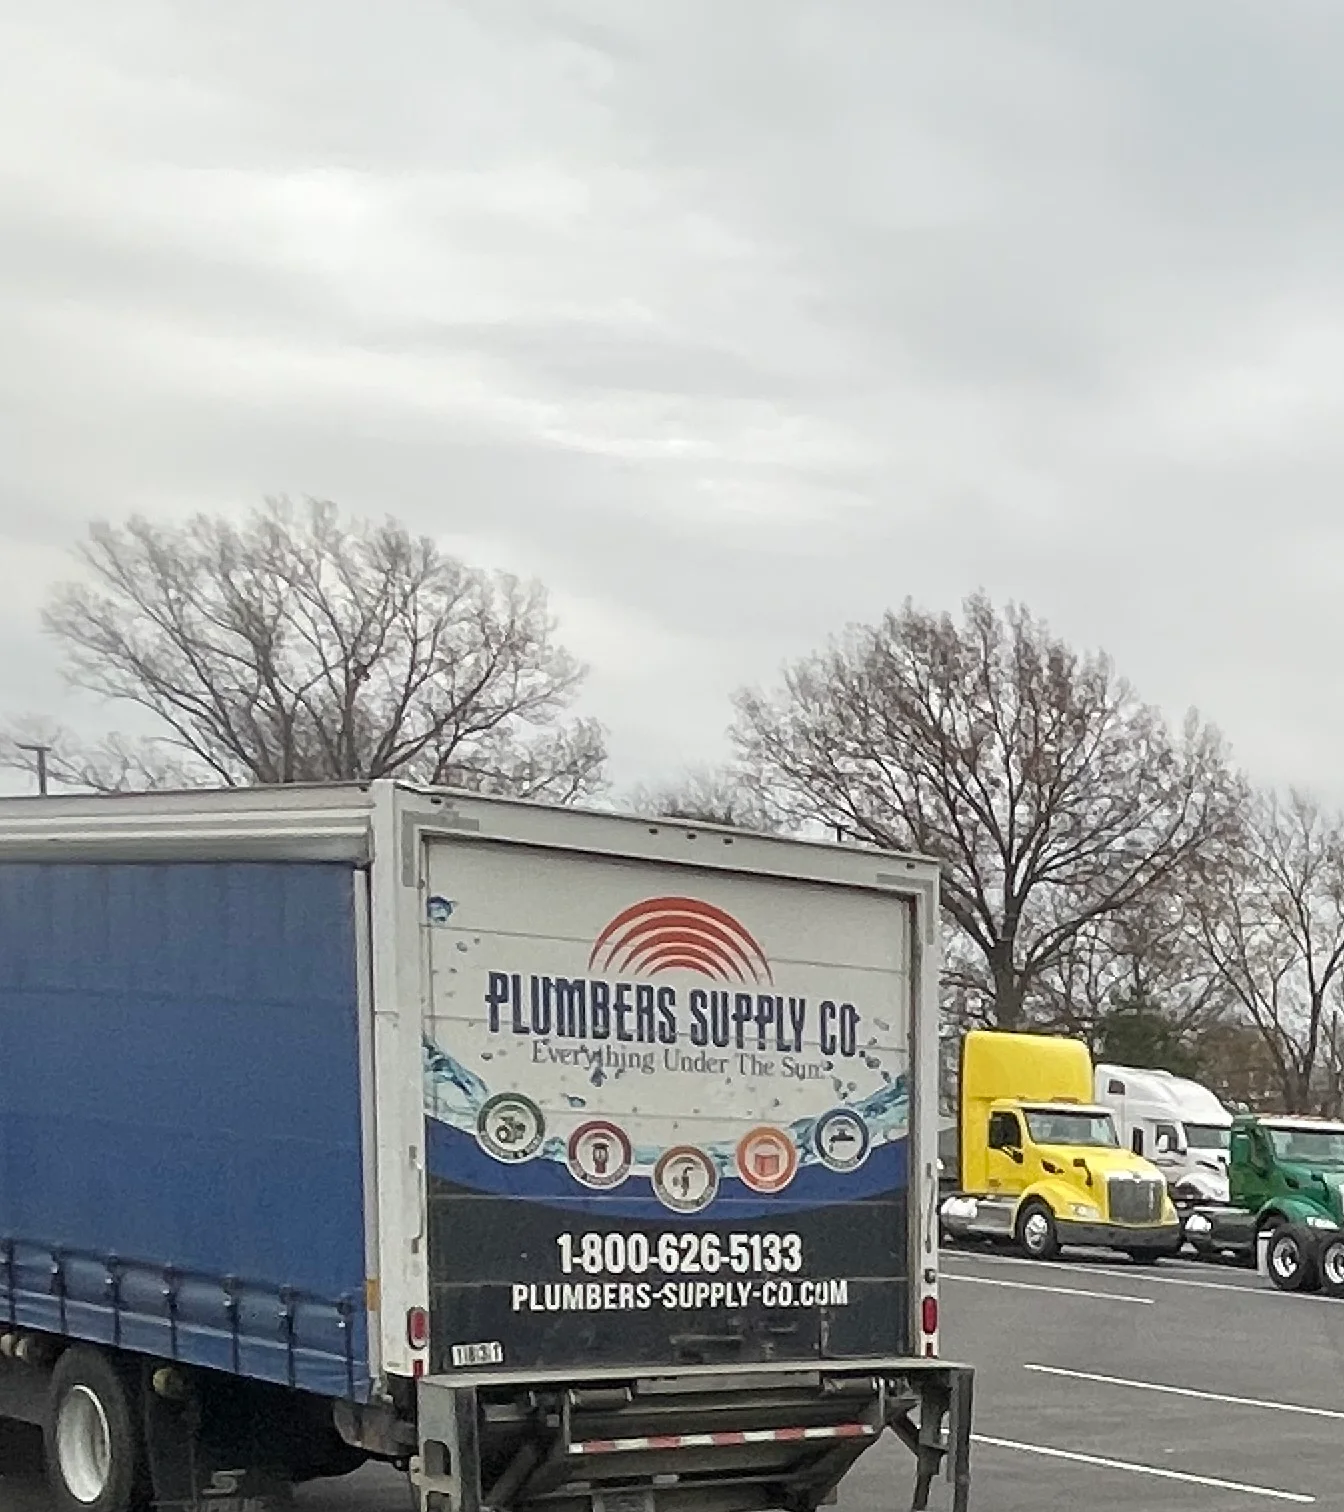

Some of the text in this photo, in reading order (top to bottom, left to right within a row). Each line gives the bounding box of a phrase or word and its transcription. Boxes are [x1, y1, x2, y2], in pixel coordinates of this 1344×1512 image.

[485, 971, 677, 1044] PLUMBERS
[690, 989, 806, 1053] SUPPLY
[531, 1040, 656, 1075] Everything
[663, 1048, 729, 1075] Under
[735, 1052, 775, 1077] The
[557, 1233, 802, 1274] 1-800-626-5133
[512, 1280, 849, 1312] PLUMBERS-SUPPLY-CO.COM
